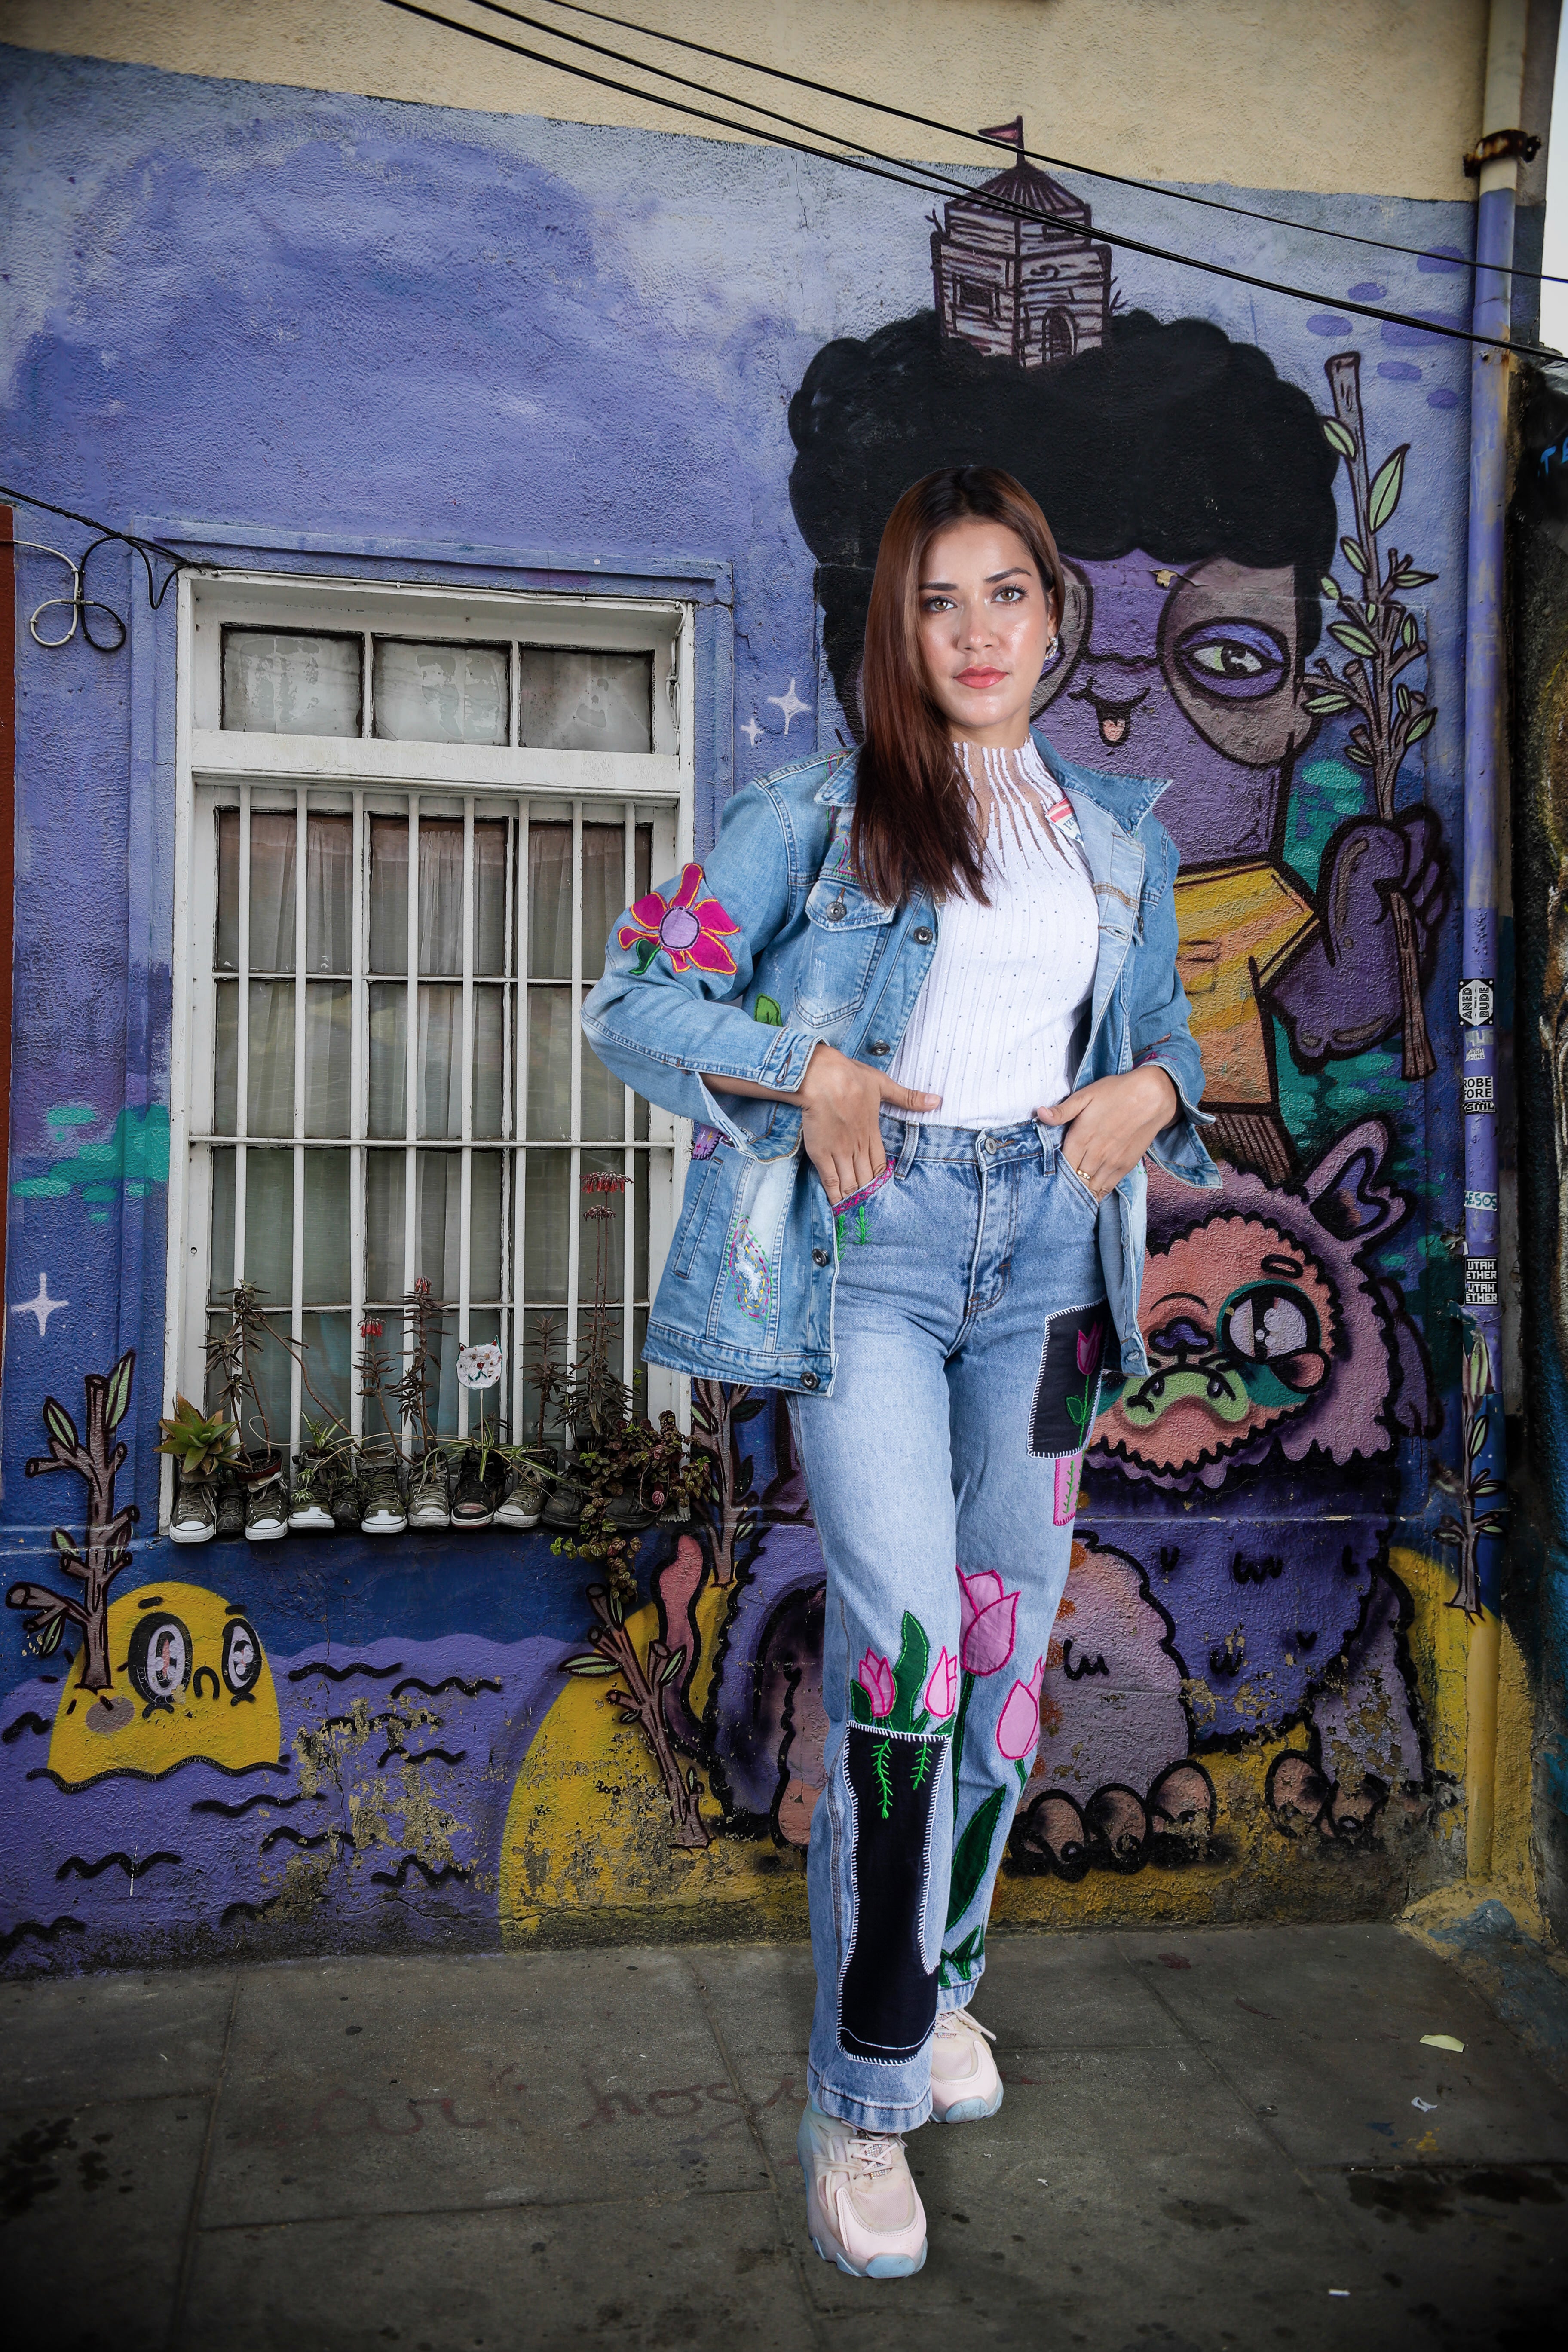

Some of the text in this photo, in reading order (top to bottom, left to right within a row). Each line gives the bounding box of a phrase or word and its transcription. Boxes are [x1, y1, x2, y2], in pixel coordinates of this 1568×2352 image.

[1462, 988, 1472, 1019] ANED
[1479, 987, 1489, 1017] BUDE
[1468, 1261, 1494, 1270] UTAH
[1466, 1271, 1497, 1279] ETHER
[1466, 1293, 1498, 1302] ETHER
